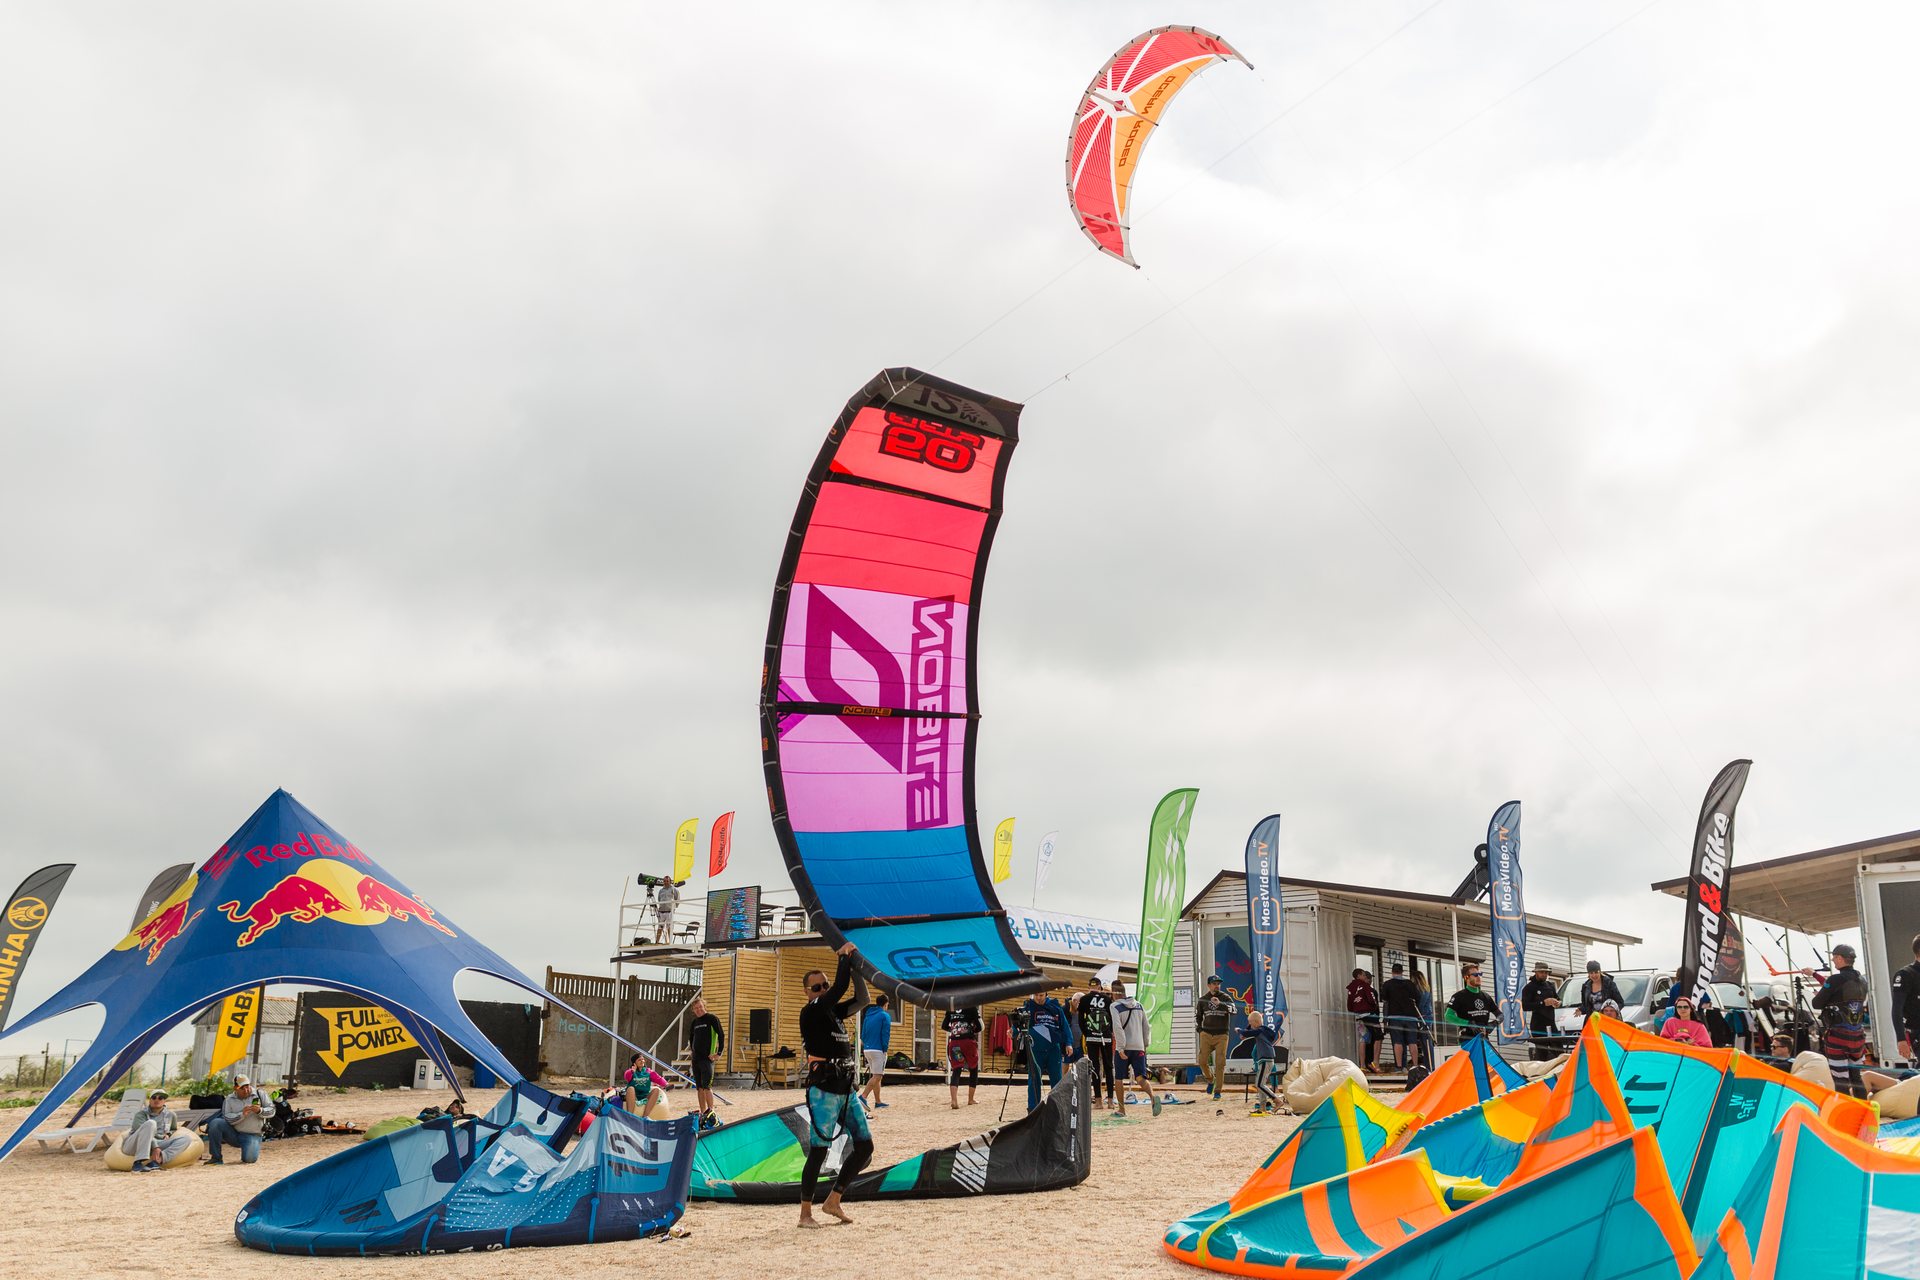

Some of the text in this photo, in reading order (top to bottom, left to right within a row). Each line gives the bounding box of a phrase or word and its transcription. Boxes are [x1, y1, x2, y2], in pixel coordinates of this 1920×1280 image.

[842, 705, 893, 717] NOBILE
[1258, 841, 1271, 926] MostVideo.TV
[1498, 826, 1513, 912] MostVideo.TV
[335, 1009, 381, 1031] FULL
[1090, 996, 1105, 1008] 46
[334, 1027, 406, 1063] POWER
[608, 1132, 659, 1178] 12
